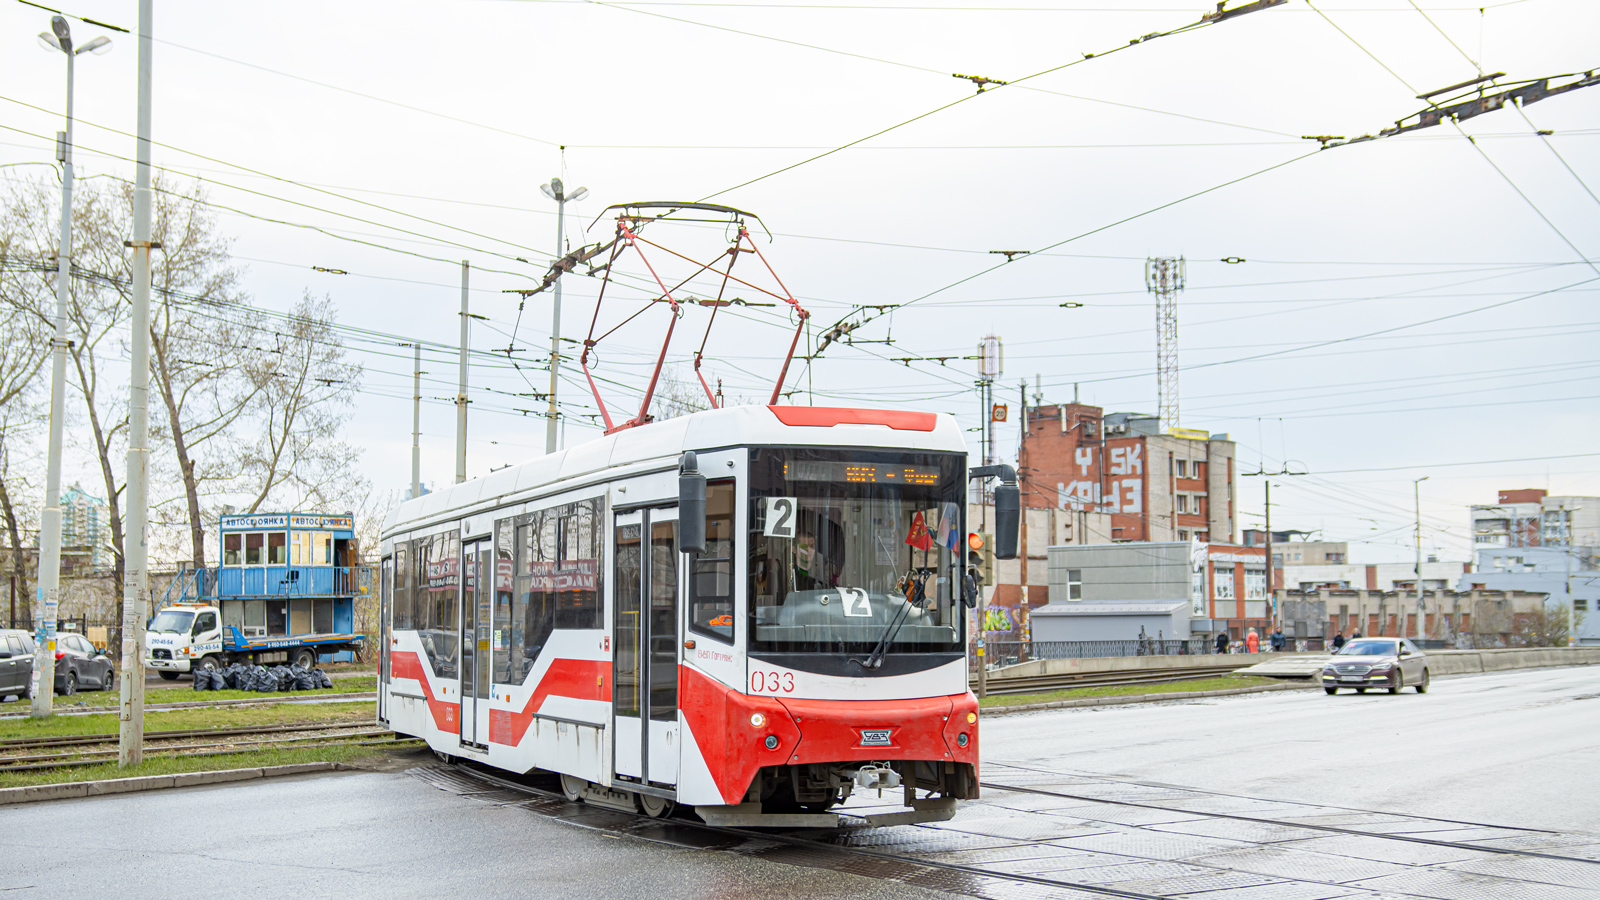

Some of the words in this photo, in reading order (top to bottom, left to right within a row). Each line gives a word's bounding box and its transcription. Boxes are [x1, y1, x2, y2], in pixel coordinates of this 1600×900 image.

[772, 499, 793, 535] 2
[846, 587, 869, 615] 2
[751, 671, 795, 693] 033
